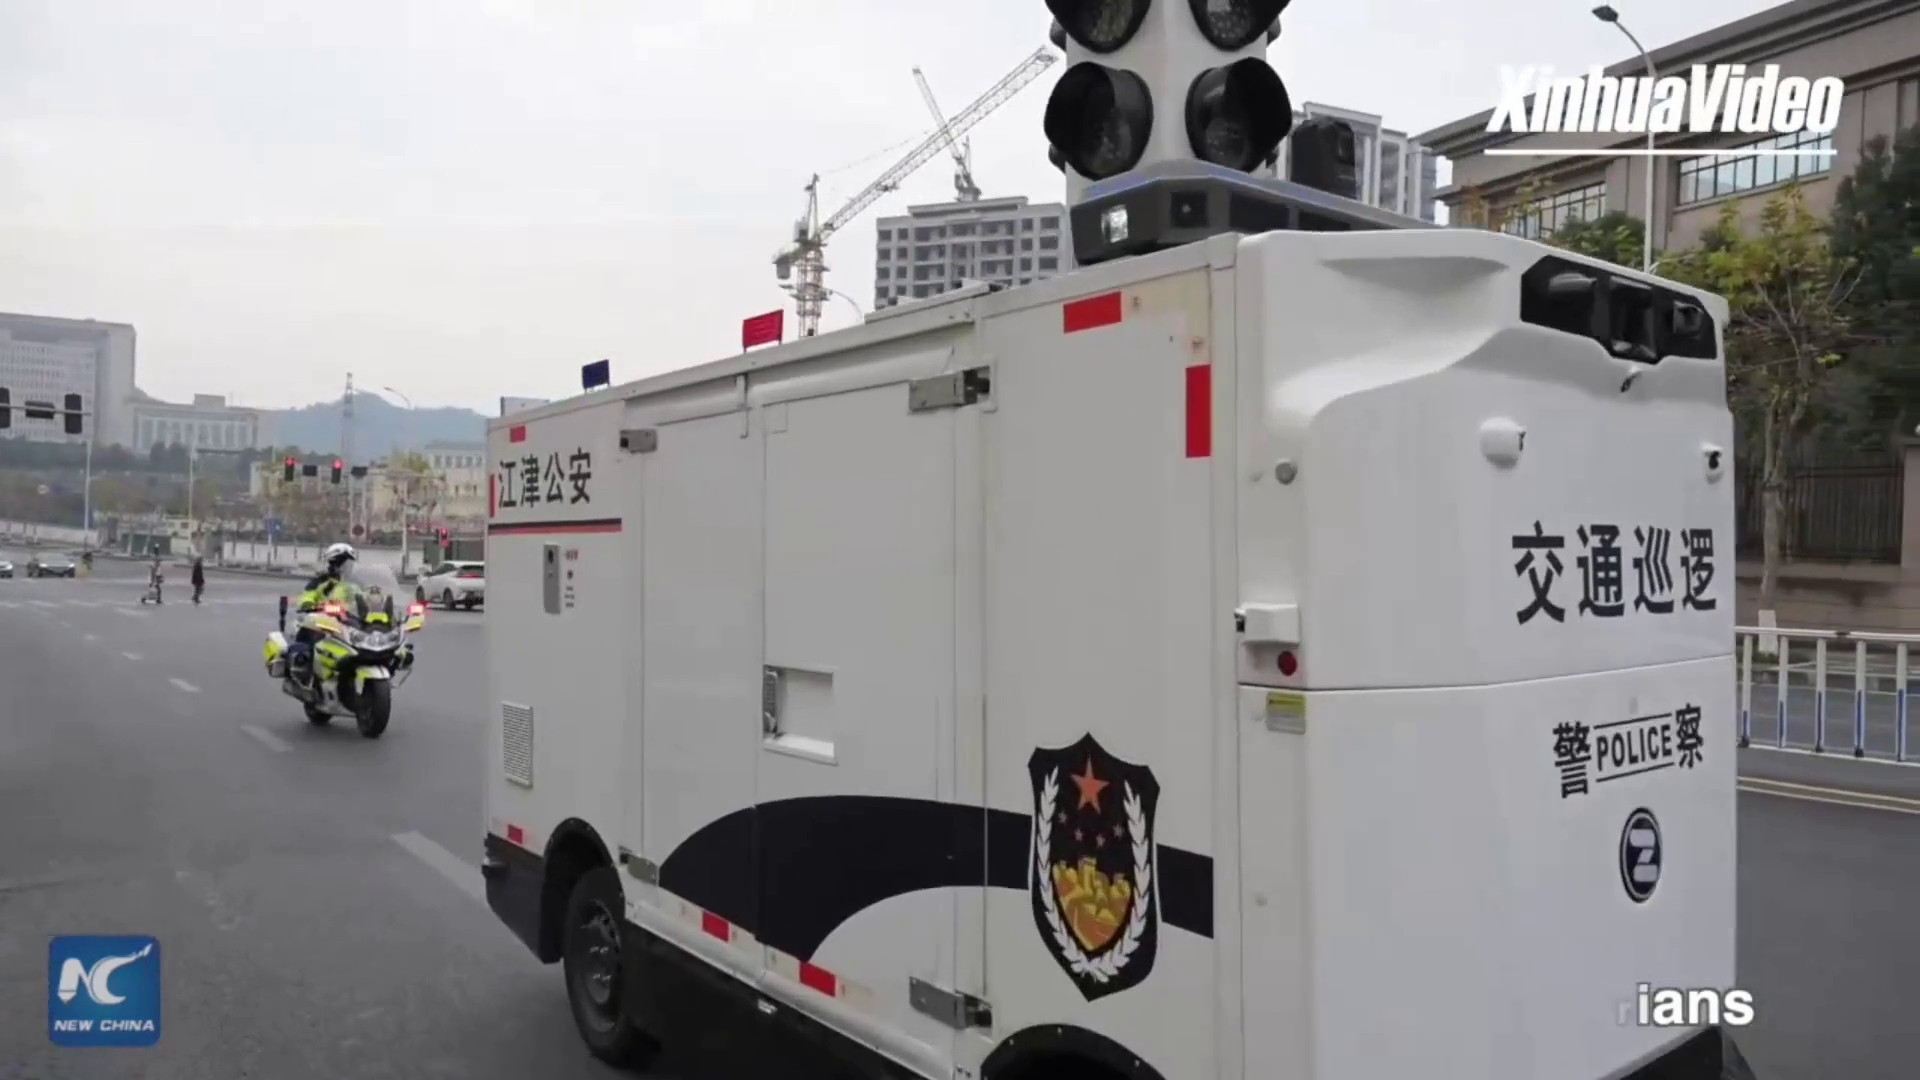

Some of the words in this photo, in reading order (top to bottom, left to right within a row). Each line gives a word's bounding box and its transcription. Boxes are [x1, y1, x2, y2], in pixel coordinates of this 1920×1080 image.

[498, 447, 592, 508] 江津公安
[1511, 520, 1717, 625] 交通巡逻
[1553, 721, 1592, 799] 警
[1596, 724, 1673, 772] POLICE
[1675, 702, 1704, 769] 察
